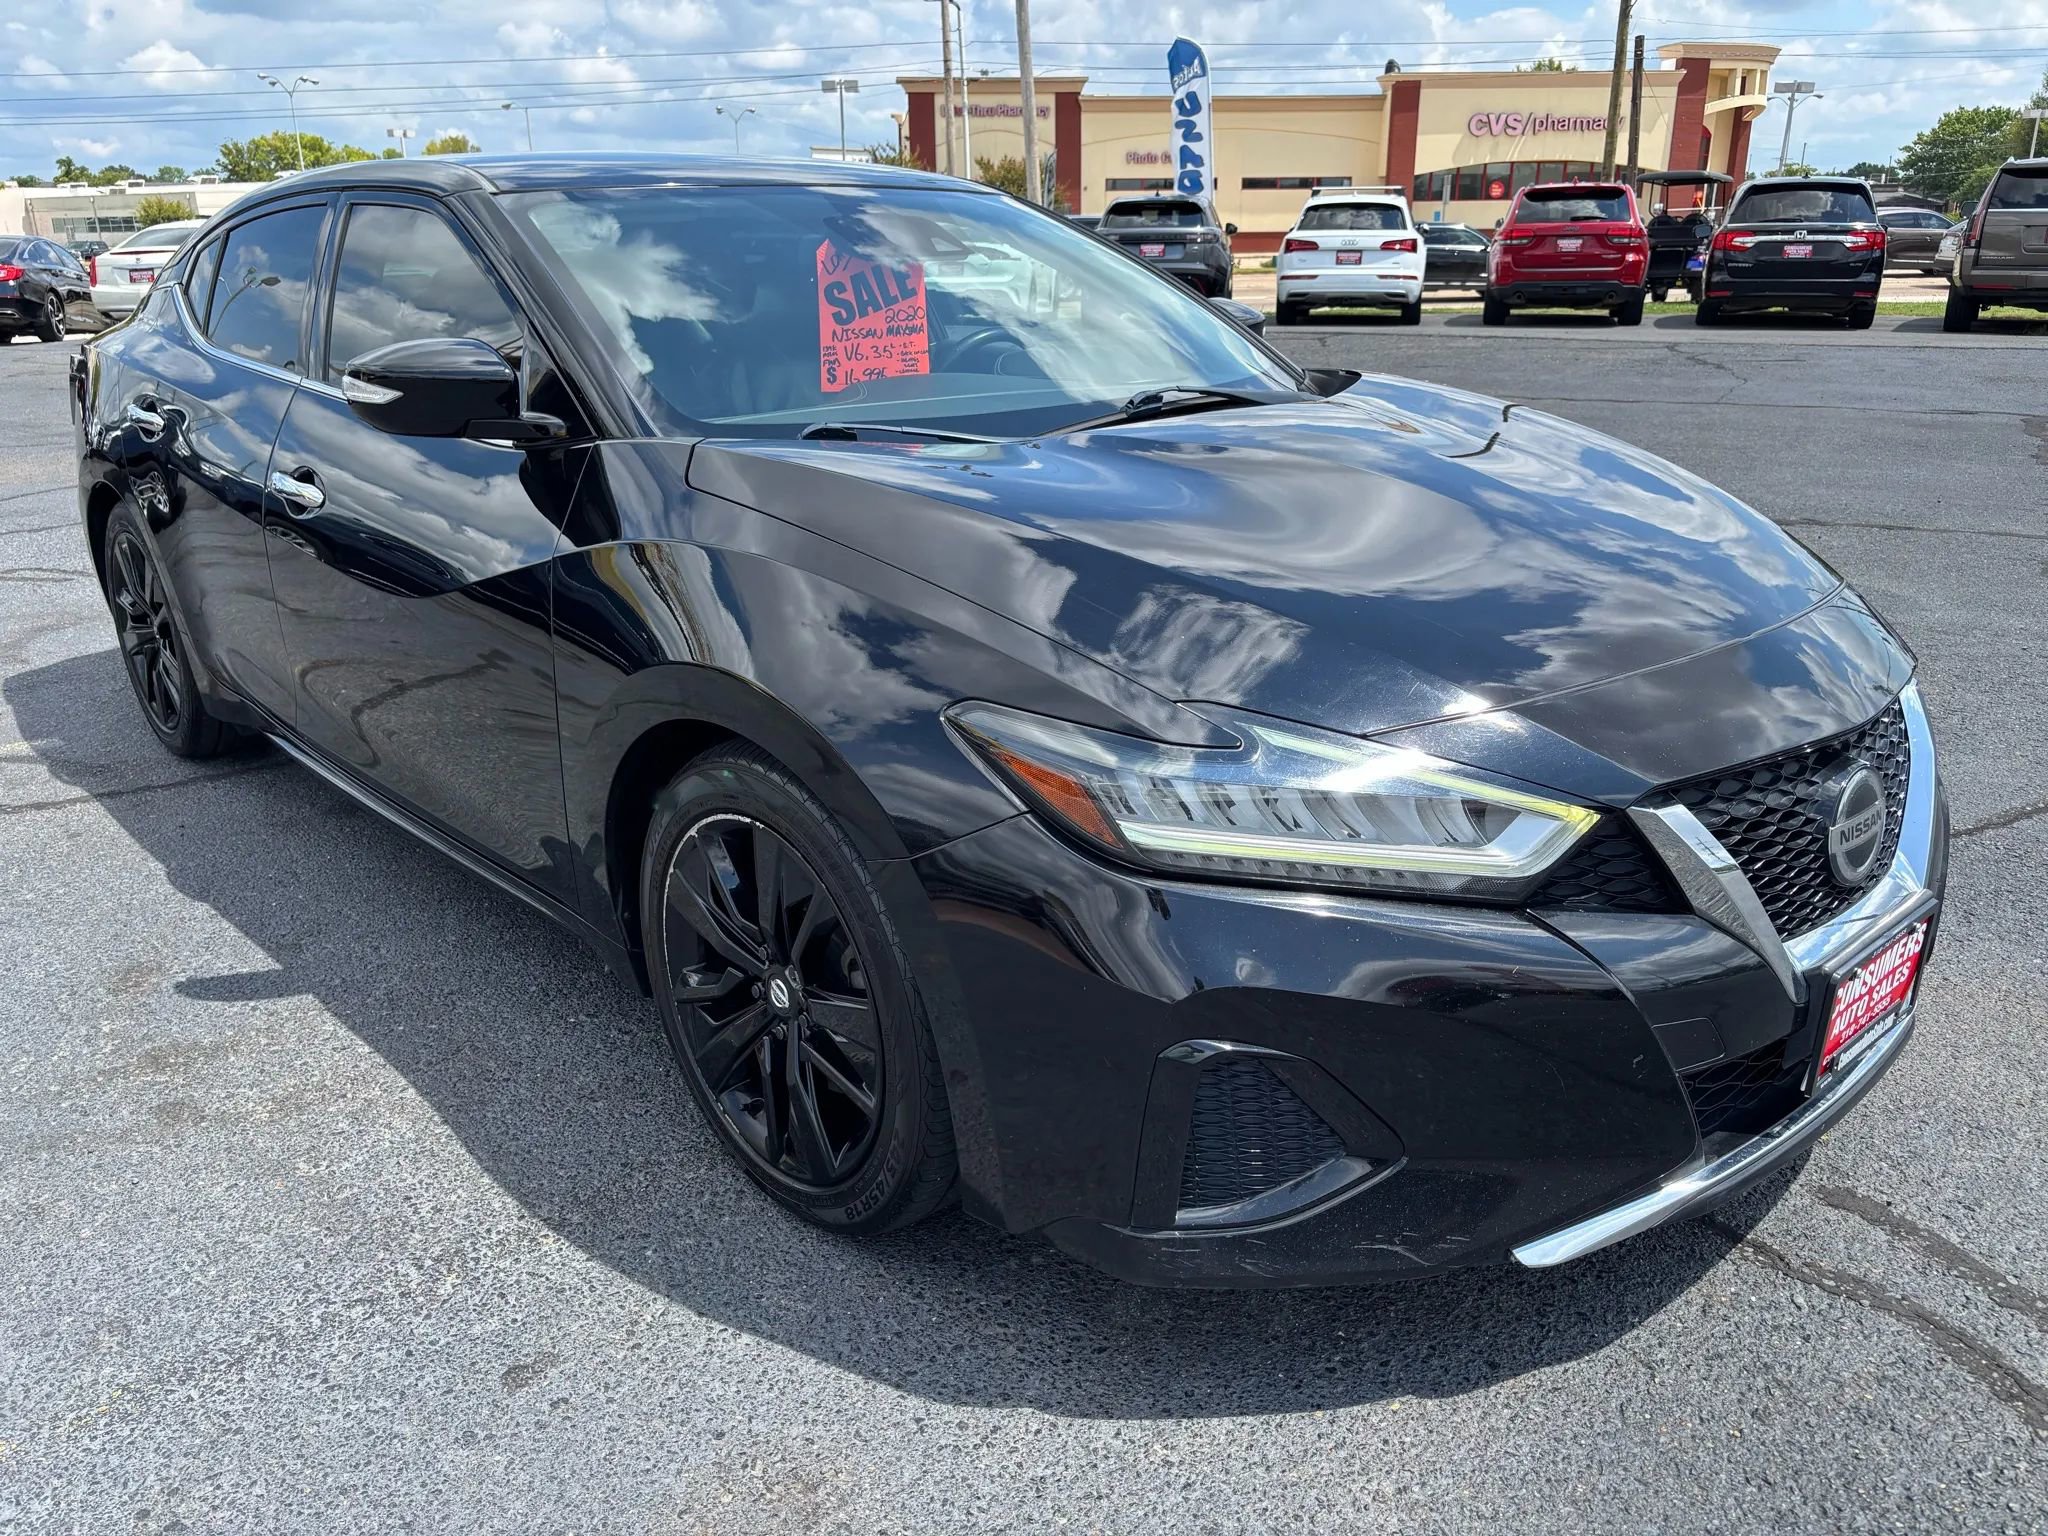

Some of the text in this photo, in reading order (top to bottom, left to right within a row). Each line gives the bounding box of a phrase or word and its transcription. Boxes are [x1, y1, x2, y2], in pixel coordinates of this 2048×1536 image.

[1126, 151, 1158, 164] Photo
[823, 264, 918, 327] SALE
[885, 305, 926, 325] 2020
[832, 327, 884, 343] NISSAN
[1839, 808, 1882, 846] NISSAN
[1829, 960, 1912, 1041] AUTO SALES
